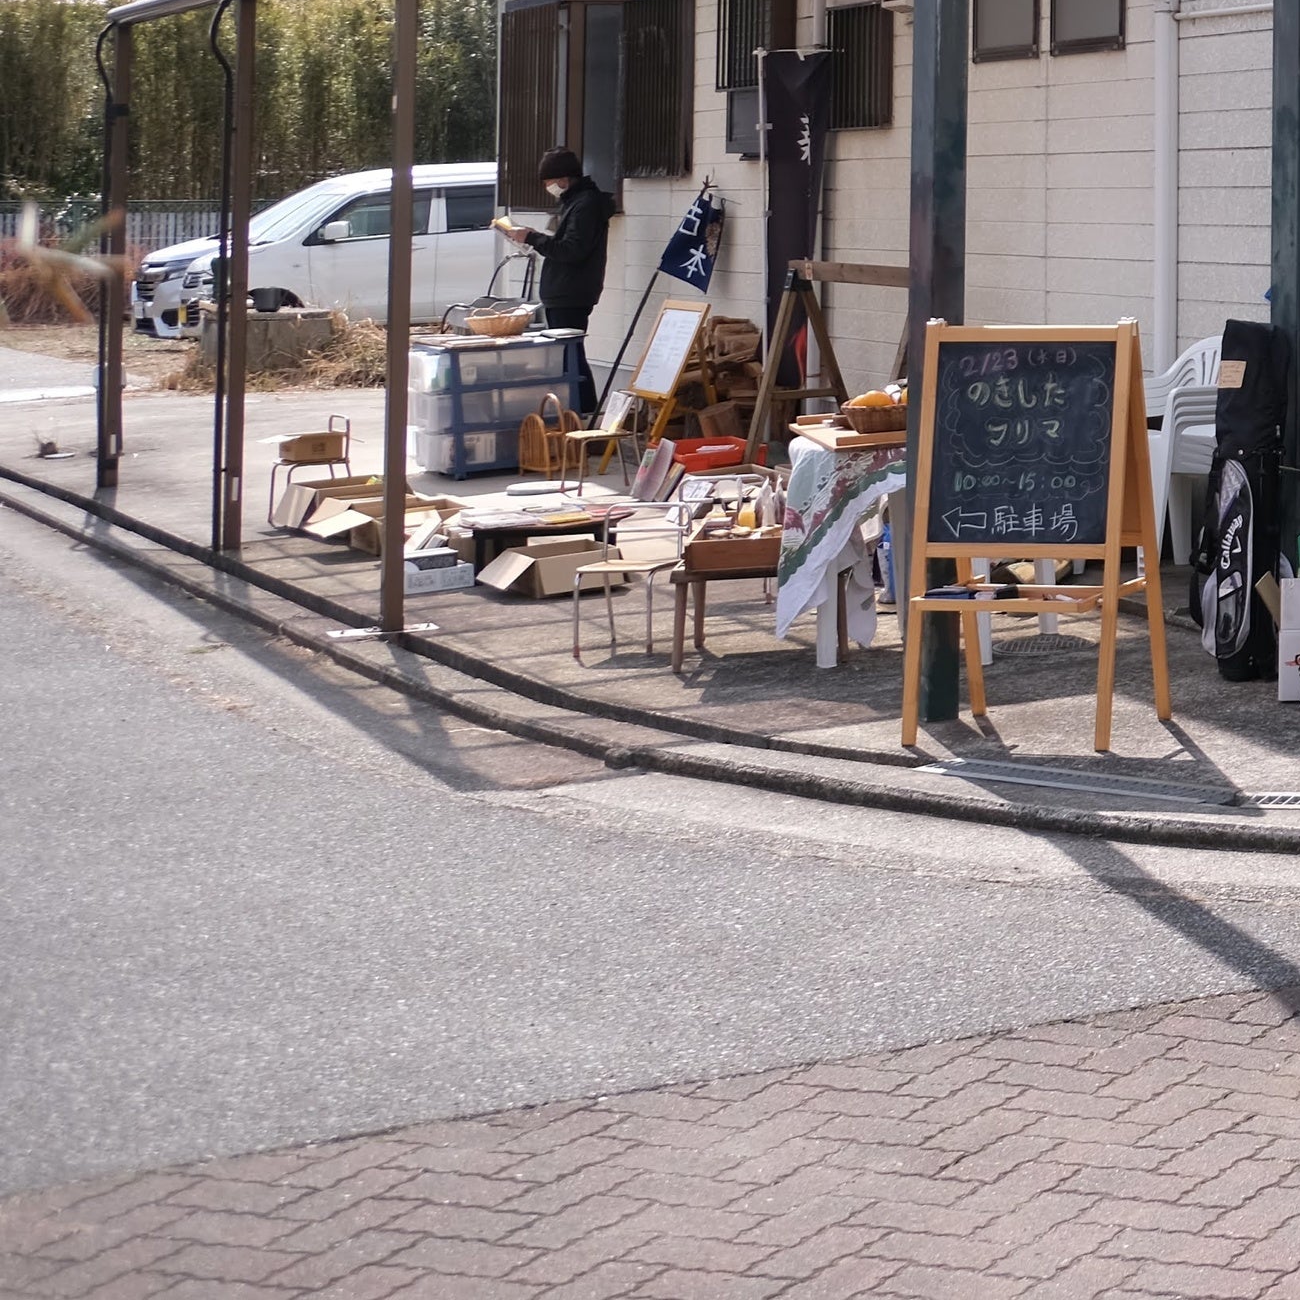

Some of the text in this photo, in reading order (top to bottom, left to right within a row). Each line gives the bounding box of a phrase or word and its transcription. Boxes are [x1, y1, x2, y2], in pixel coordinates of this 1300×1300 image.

[960, 348, 1019, 377] 2/23
[968, 372, 1065, 408] のきした
[987, 419, 1060, 446] フリマ
[991, 503, 1079, 541] 駐車場
[1221, 514, 1244, 570] Callaway
